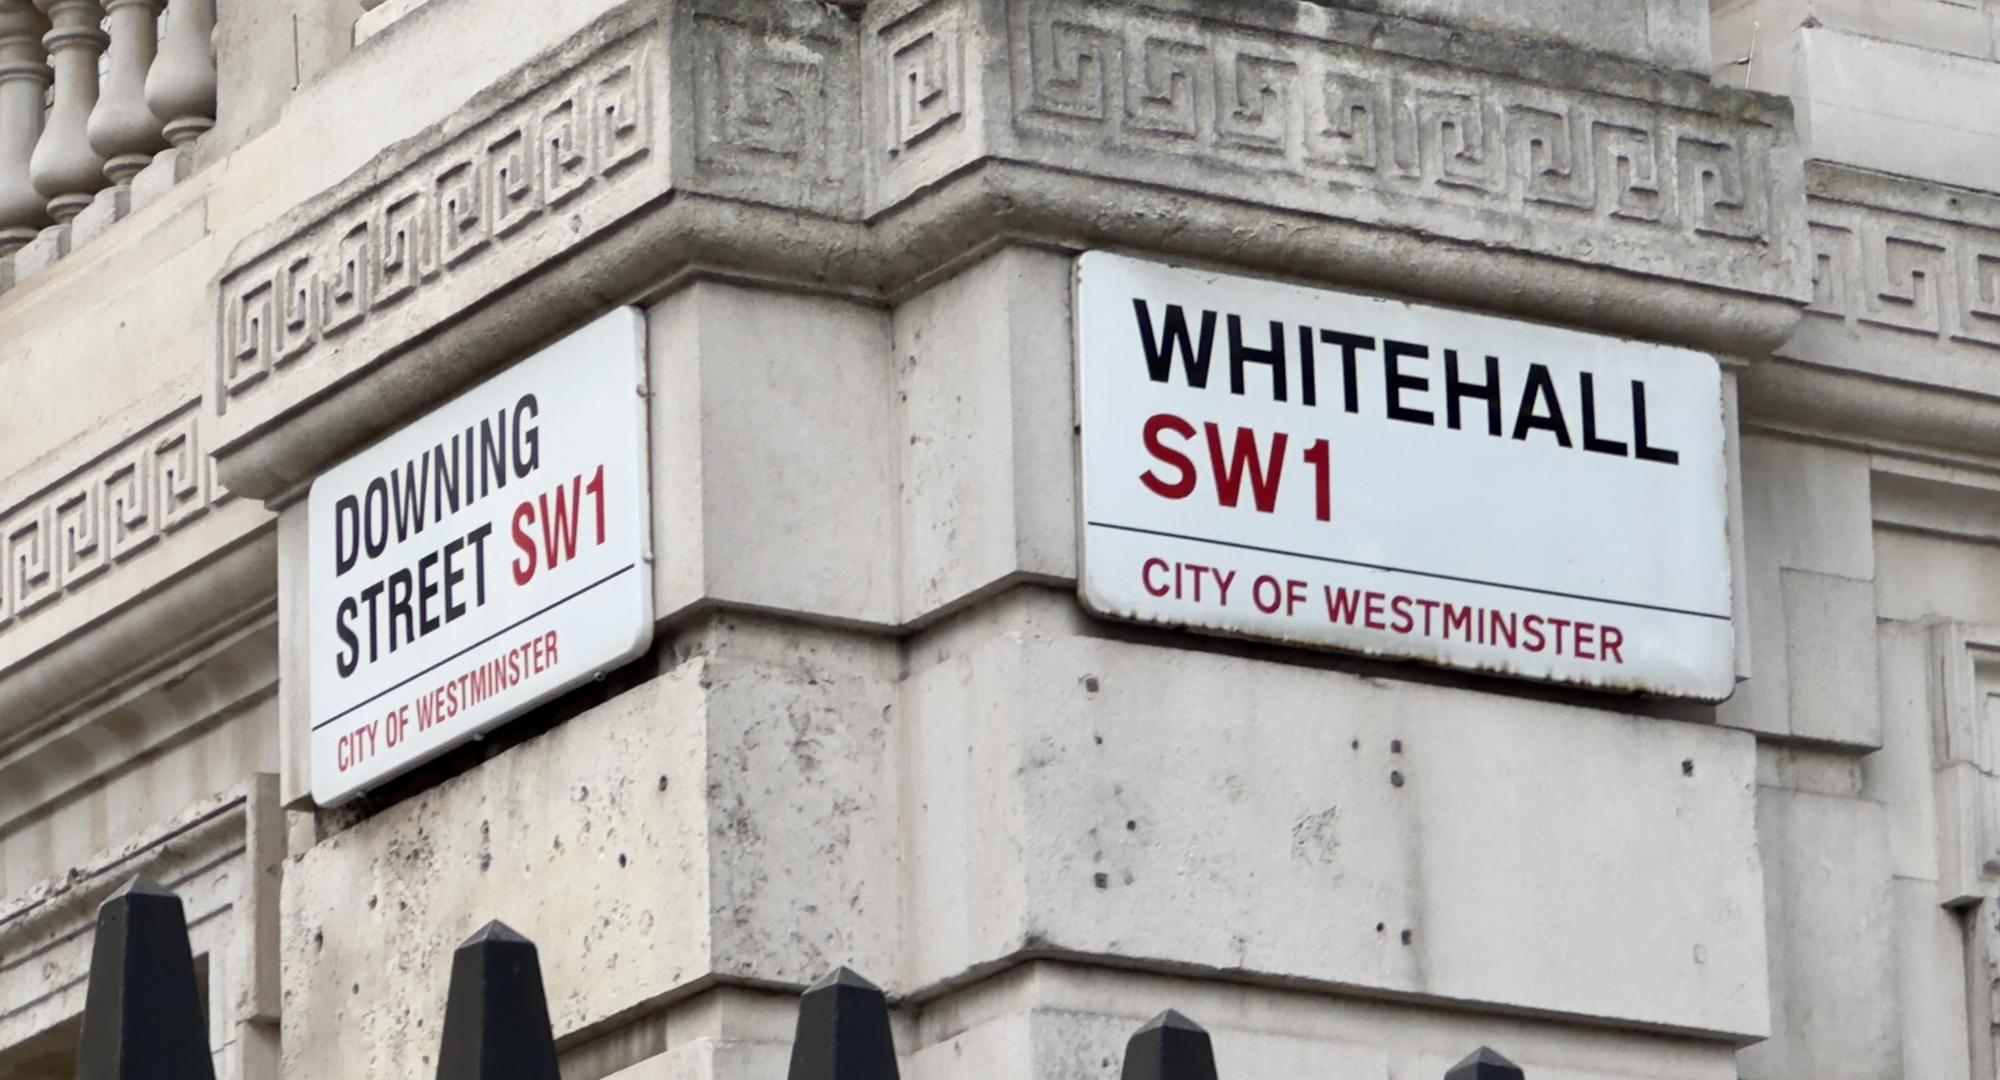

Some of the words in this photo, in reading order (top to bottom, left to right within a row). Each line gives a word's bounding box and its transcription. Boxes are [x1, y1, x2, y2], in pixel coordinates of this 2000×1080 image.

[1133, 297, 1679, 466] WHITEHALL
[335, 393, 539, 577] DOWNING
[1140, 413, 1331, 523] SW1
[336, 521, 492, 679] STREET
[511, 464, 606, 587] SW1
[1142, 557, 1236, 607] CITY
[1252, 574, 1308, 617] OF
[1323, 585, 1624, 664] WESTMINSTER
[337, 719, 378, 773] CITY
[386, 704, 409, 749] OF
[416, 630, 558, 732] WESTMINSTER
